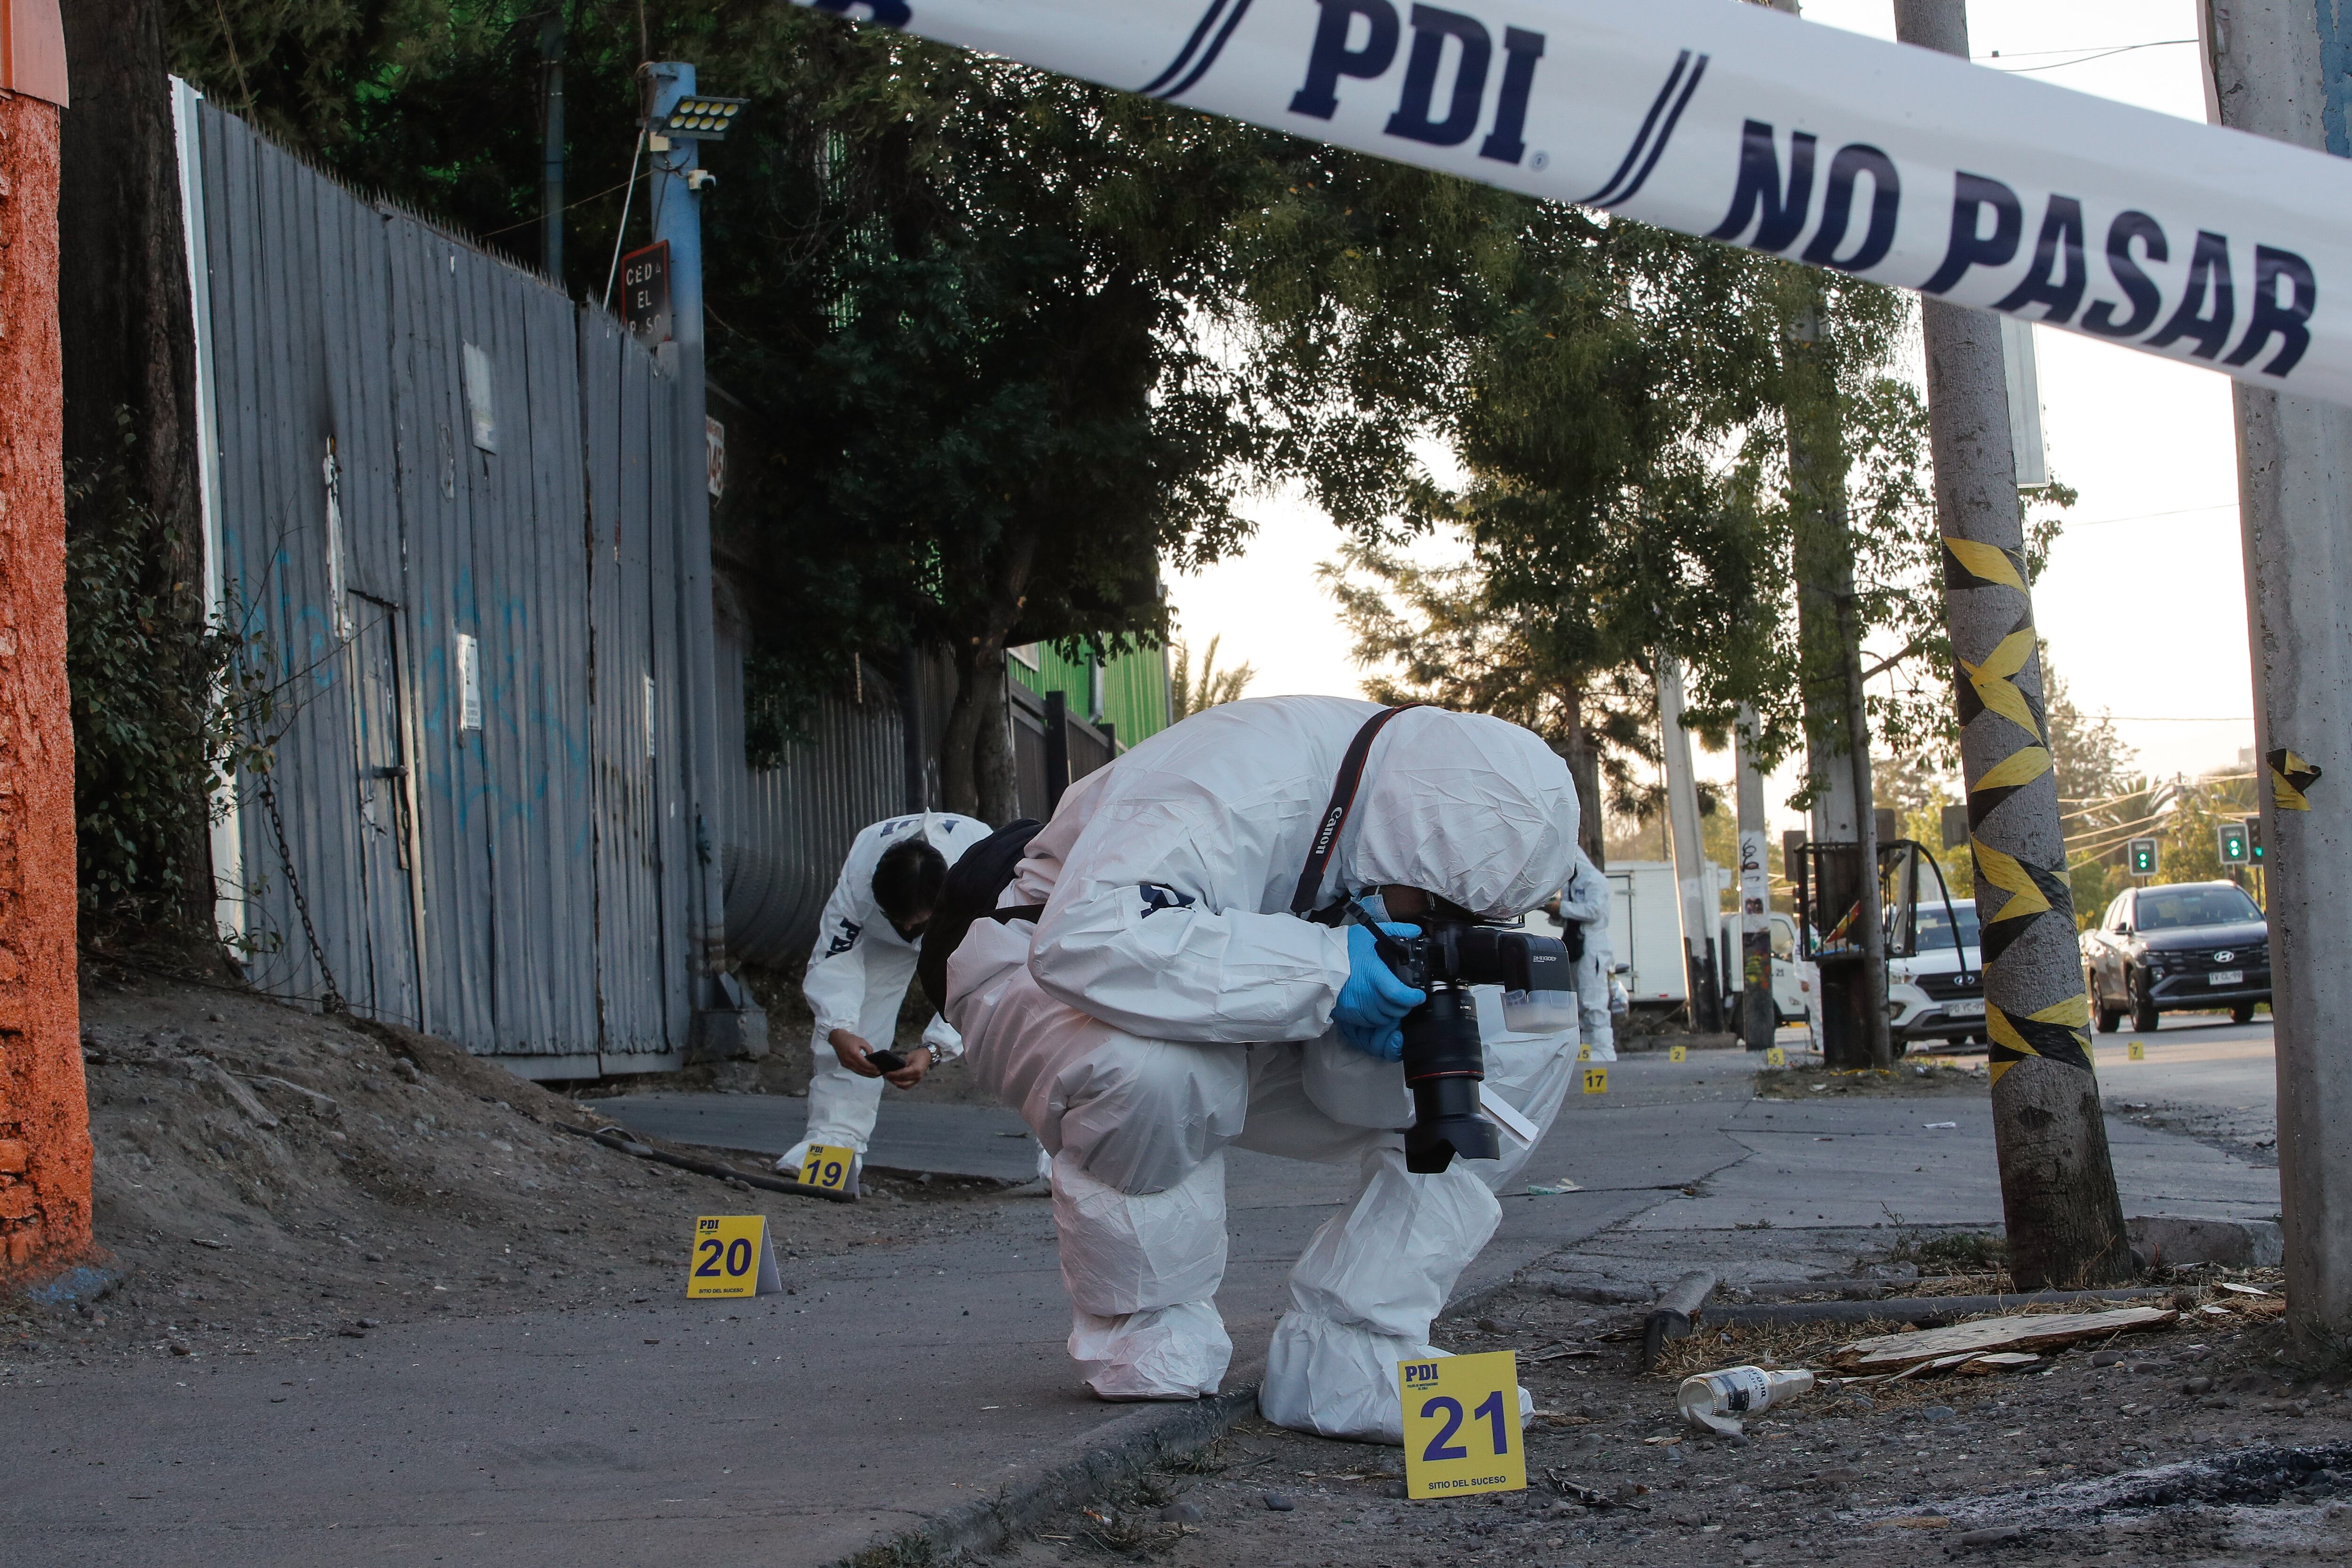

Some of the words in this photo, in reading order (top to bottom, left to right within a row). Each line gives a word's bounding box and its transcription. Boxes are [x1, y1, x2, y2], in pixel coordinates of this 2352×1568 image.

[1288, 0, 1546, 165] PDI
[1708, 119, 1901, 271] NO
[1922, 170, 2317, 377] PASAR
[638, 290, 652, 309] EL
[1315, 807, 1343, 854] Canon
[1674, 1051, 1681, 1059] 2
[2132, 1046, 2138, 1055] 7
[1586, 1075, 1604, 1088] 17
[807, 1160, 842, 1187] 19
[699, 1219, 719, 1229] PDI
[695, 1238, 752, 1276] 20
[1405, 1363, 1438, 1382] PDI
[1420, 1391, 1508, 1461] 21
[1429, 1481, 1450, 1490] SITIO
[1471, 1475, 1506, 1486] SUCESO
